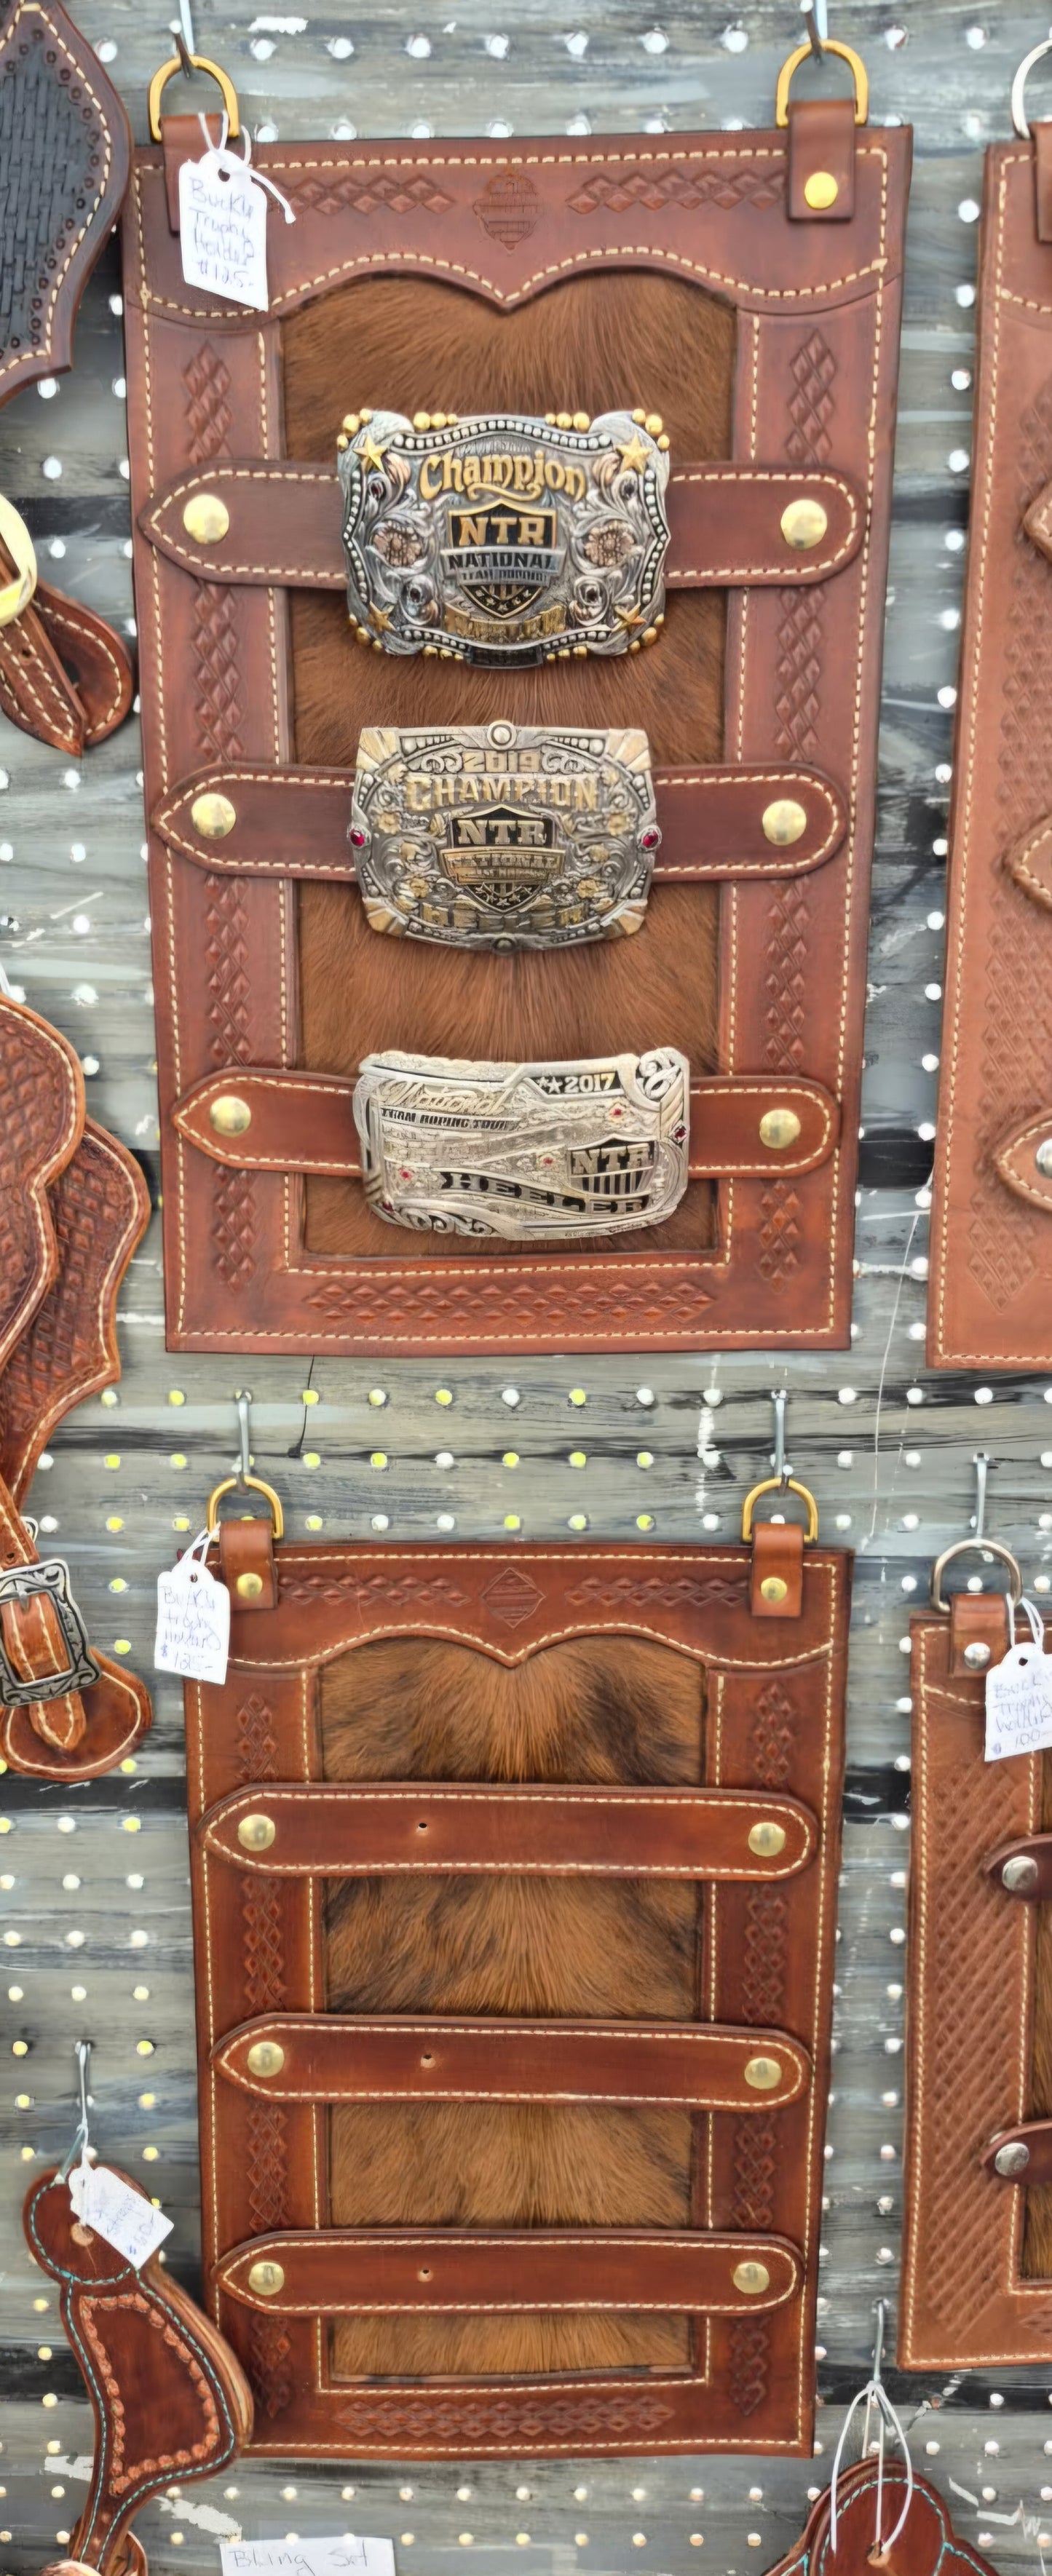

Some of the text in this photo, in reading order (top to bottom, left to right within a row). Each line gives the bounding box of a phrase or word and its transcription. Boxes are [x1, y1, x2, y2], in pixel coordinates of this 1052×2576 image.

[419, 450, 586, 502] Champion
[458, 516, 545, 546] NTR
[463, 751, 542, 773] 2019
[404, 774, 598, 812] CHAMPION
[458, 820, 547, 845] NTR
[565, 1072, 616, 1093] 2017
[572, 1144, 650, 1174] NTR
[446, 1172, 645, 1214] HEELER
